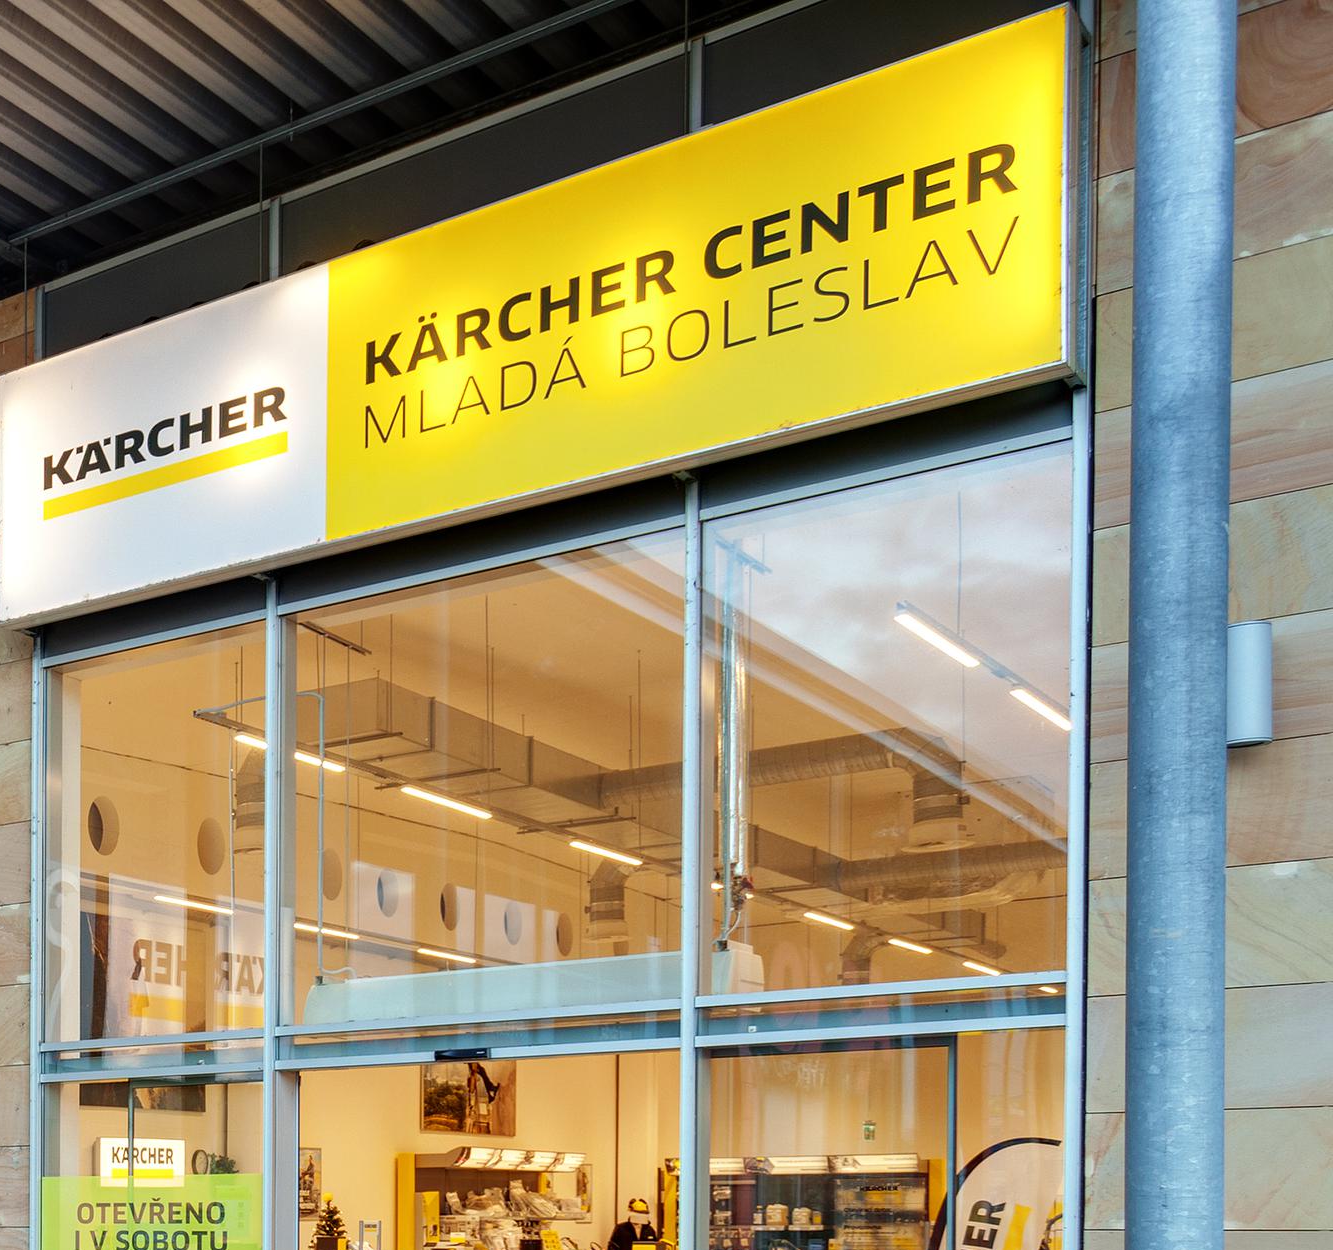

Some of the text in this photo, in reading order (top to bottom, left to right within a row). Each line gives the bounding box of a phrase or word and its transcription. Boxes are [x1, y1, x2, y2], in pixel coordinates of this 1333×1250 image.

[365, 143, 1019, 385] KÄRCHER CENTER
[364, 215, 1020, 449] MLADÁ BOLESLAV
[43, 385, 287, 491] KÄRCHER
[111, 1146, 174, 1165] KÄRCHER
[74, 1230, 80, 1250] I
[76, 1197, 226, 1225] OTEVŘENO
